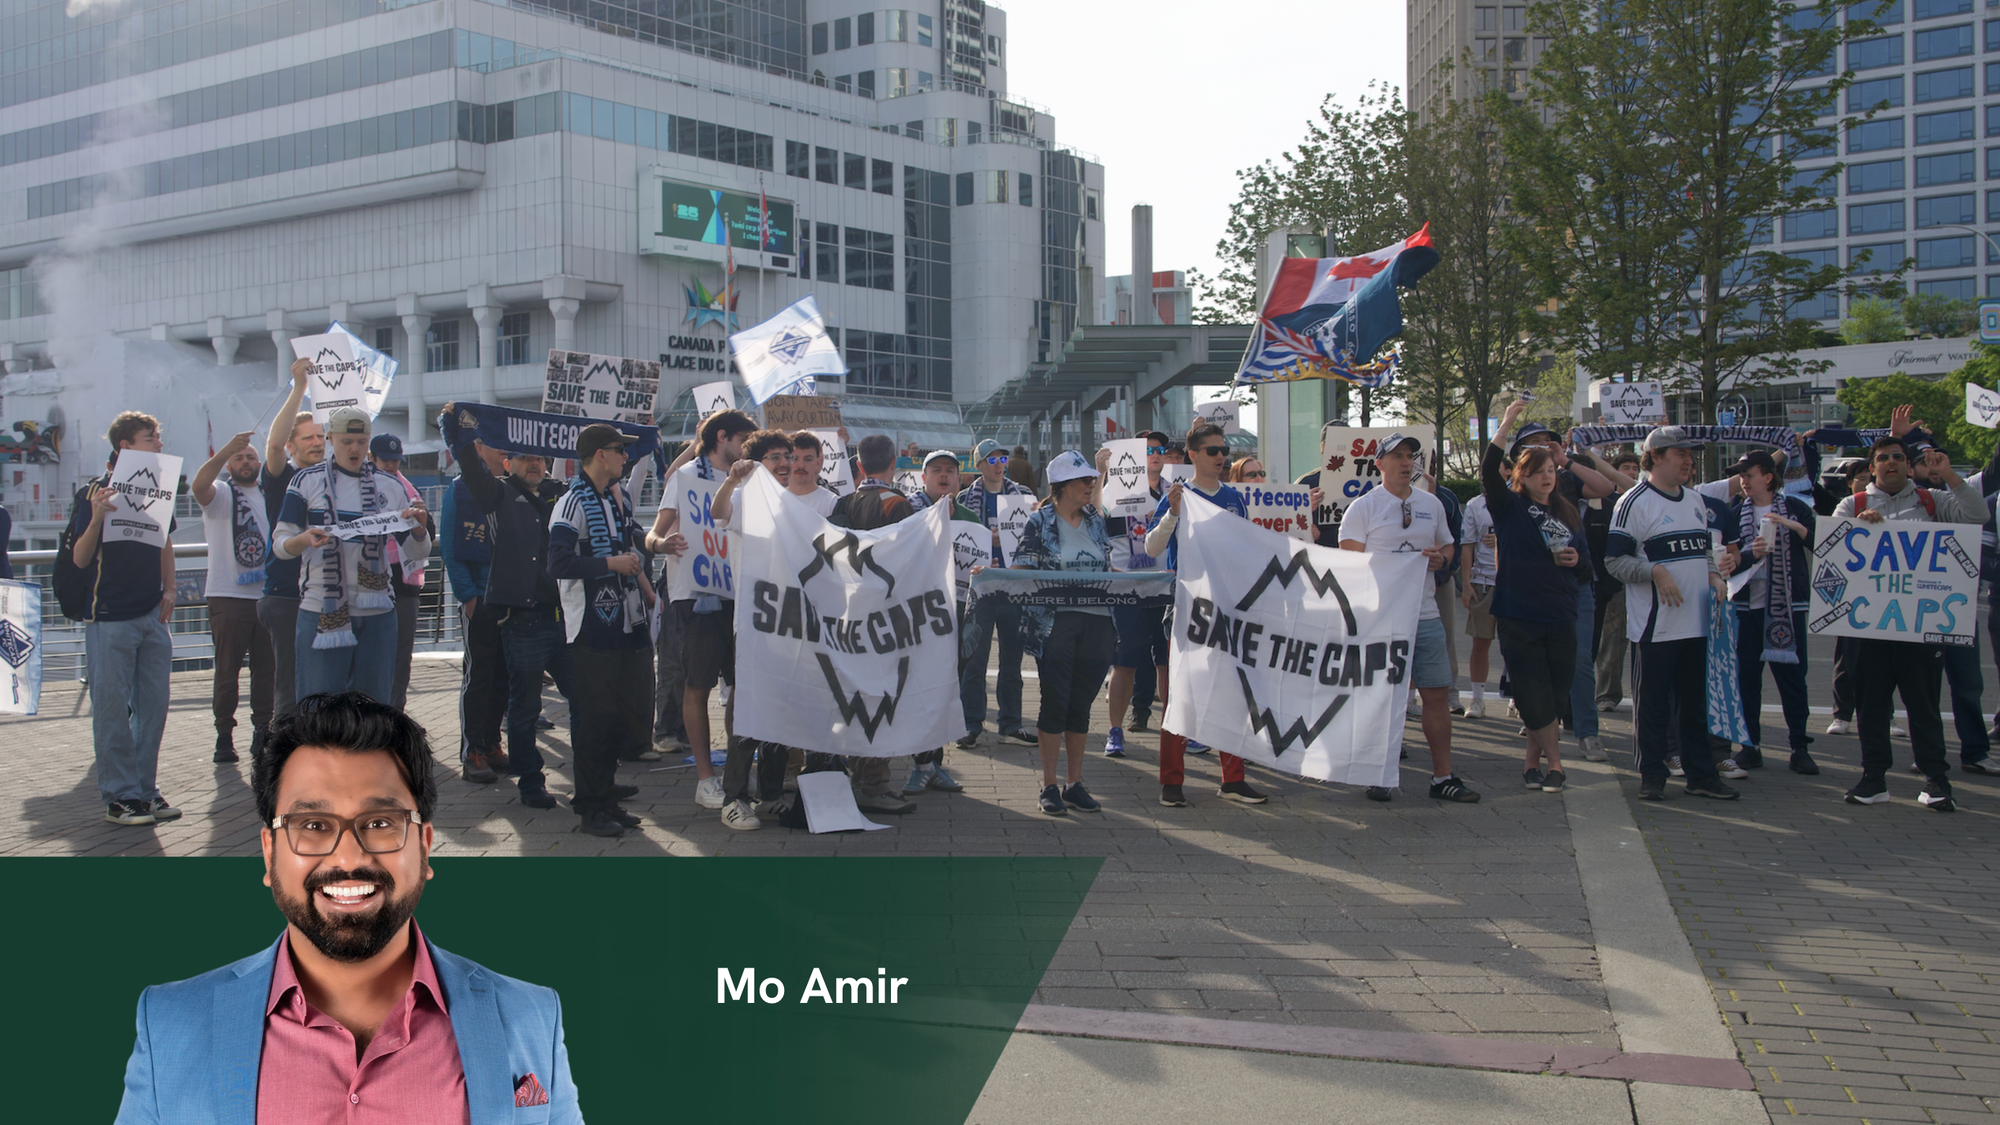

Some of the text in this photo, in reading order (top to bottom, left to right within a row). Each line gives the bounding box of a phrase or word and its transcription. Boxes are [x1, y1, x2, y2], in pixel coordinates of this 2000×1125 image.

[668, 335, 716, 353] CANADA
[305, 364, 325, 376] SAVE
[324, 364, 336, 373] THE
[335, 361, 357, 373] CAPS
[659, 353, 697, 371] PLACE
[698, 357, 714, 371] DU
[1888, 349, 1943, 368] Fairmont
[547, 381, 653, 411] SAVE THE CAPS
[1610, 399, 1627, 408] SAVE
[1636, 398, 1654, 407] CAPS
[767, 410, 843, 427] AWAY OUR TEAM
[1205, 415, 1216, 423] SAVE
[1223, 414, 1234, 422] CAPS
[506, 416, 581, 452] WHITECA
[829, 451, 846, 461] CAPS
[1350, 438, 1380, 458] SA
[1109, 465, 1146, 477] SAVE THE CAPS
[1353, 458, 1381, 477] TH
[111, 481, 173, 501] SAVE THE CAPS
[1343, 479, 1376, 498] CA
[1319, 501, 1343, 524] It's
[463, 521, 486, 543] 74
[1000, 521, 1015, 531] SAVE
[1016, 521, 1025, 529] THE
[703, 529, 728, 560] OU
[1815, 521, 1852, 557] SAVE THE CAPS
[960, 544, 971, 554] THE
[971, 547, 989, 560] CAPS
[1844, 527, 1955, 573] SAVE
[1945, 537, 1958, 554] SAVE
[1961, 559, 1978, 577] CAPS
[692, 553, 733, 592] CAP
[1066, 560, 1081, 569] SAVE
[1814, 580, 1846, 588] WHITECAPS
[1868, 573, 1913, 594] THE
[1917, 583, 1953, 592] WHITECAPS
[1007, 597, 1138, 606] WHERE I BELONG
[822, 615, 868, 655] THE
[867, 588, 954, 655] CAPS
[1811, 602, 1852, 633] SAVE THE CAPS
[1848, 592, 1968, 634] CAPS
[3, 622, 18, 666] WHITECAPS
[1187, 596, 1410, 688] SAVE THE CAPS
[1925, 633, 1943, 643] SAVE
[1954, 636, 1974, 646] CAPS
[1720, 647, 1729, 676] IN
[1715, 652, 1733, 741] BELONG
